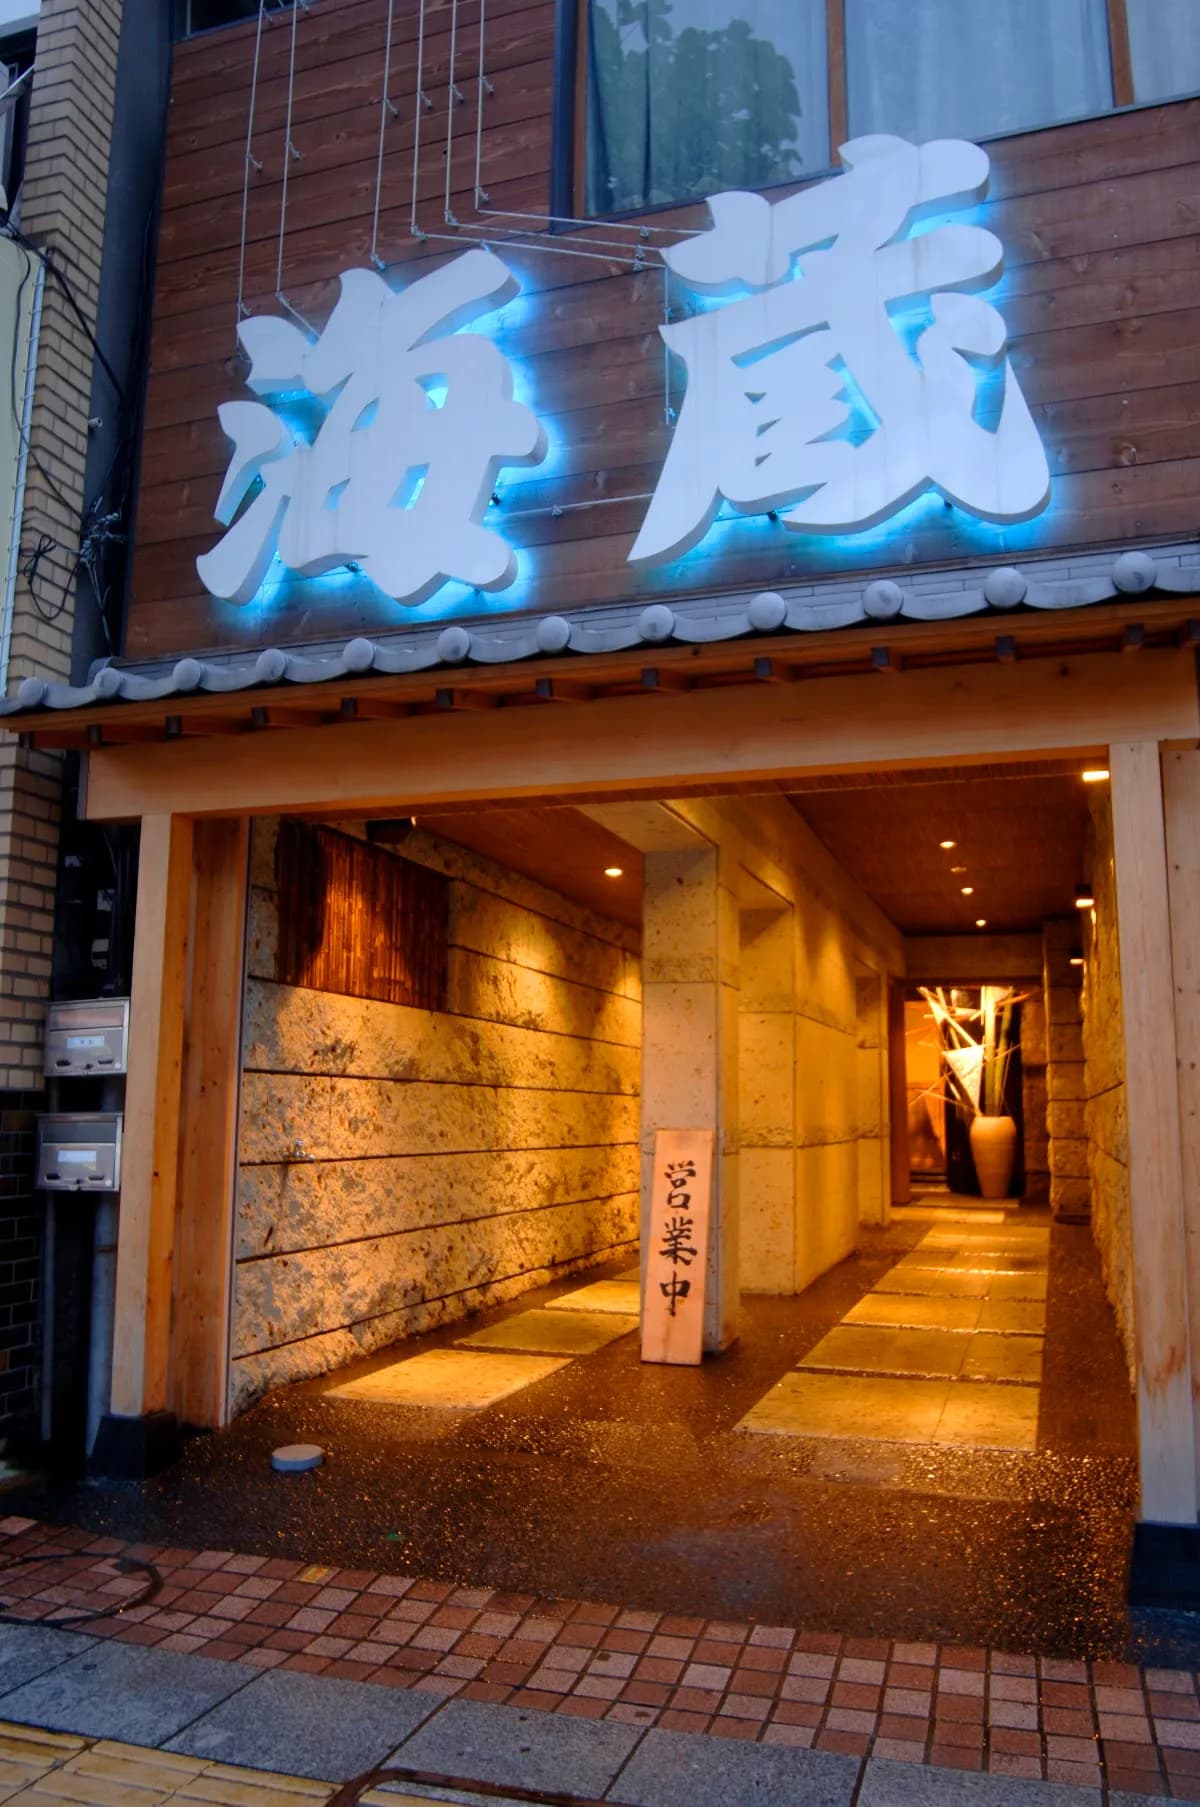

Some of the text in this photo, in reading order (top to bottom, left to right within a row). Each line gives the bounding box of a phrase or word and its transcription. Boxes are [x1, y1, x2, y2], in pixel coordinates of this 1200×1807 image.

[196, 133, 1051, 607] 海蔵
[658, 1159, 698, 1317] 営業中
